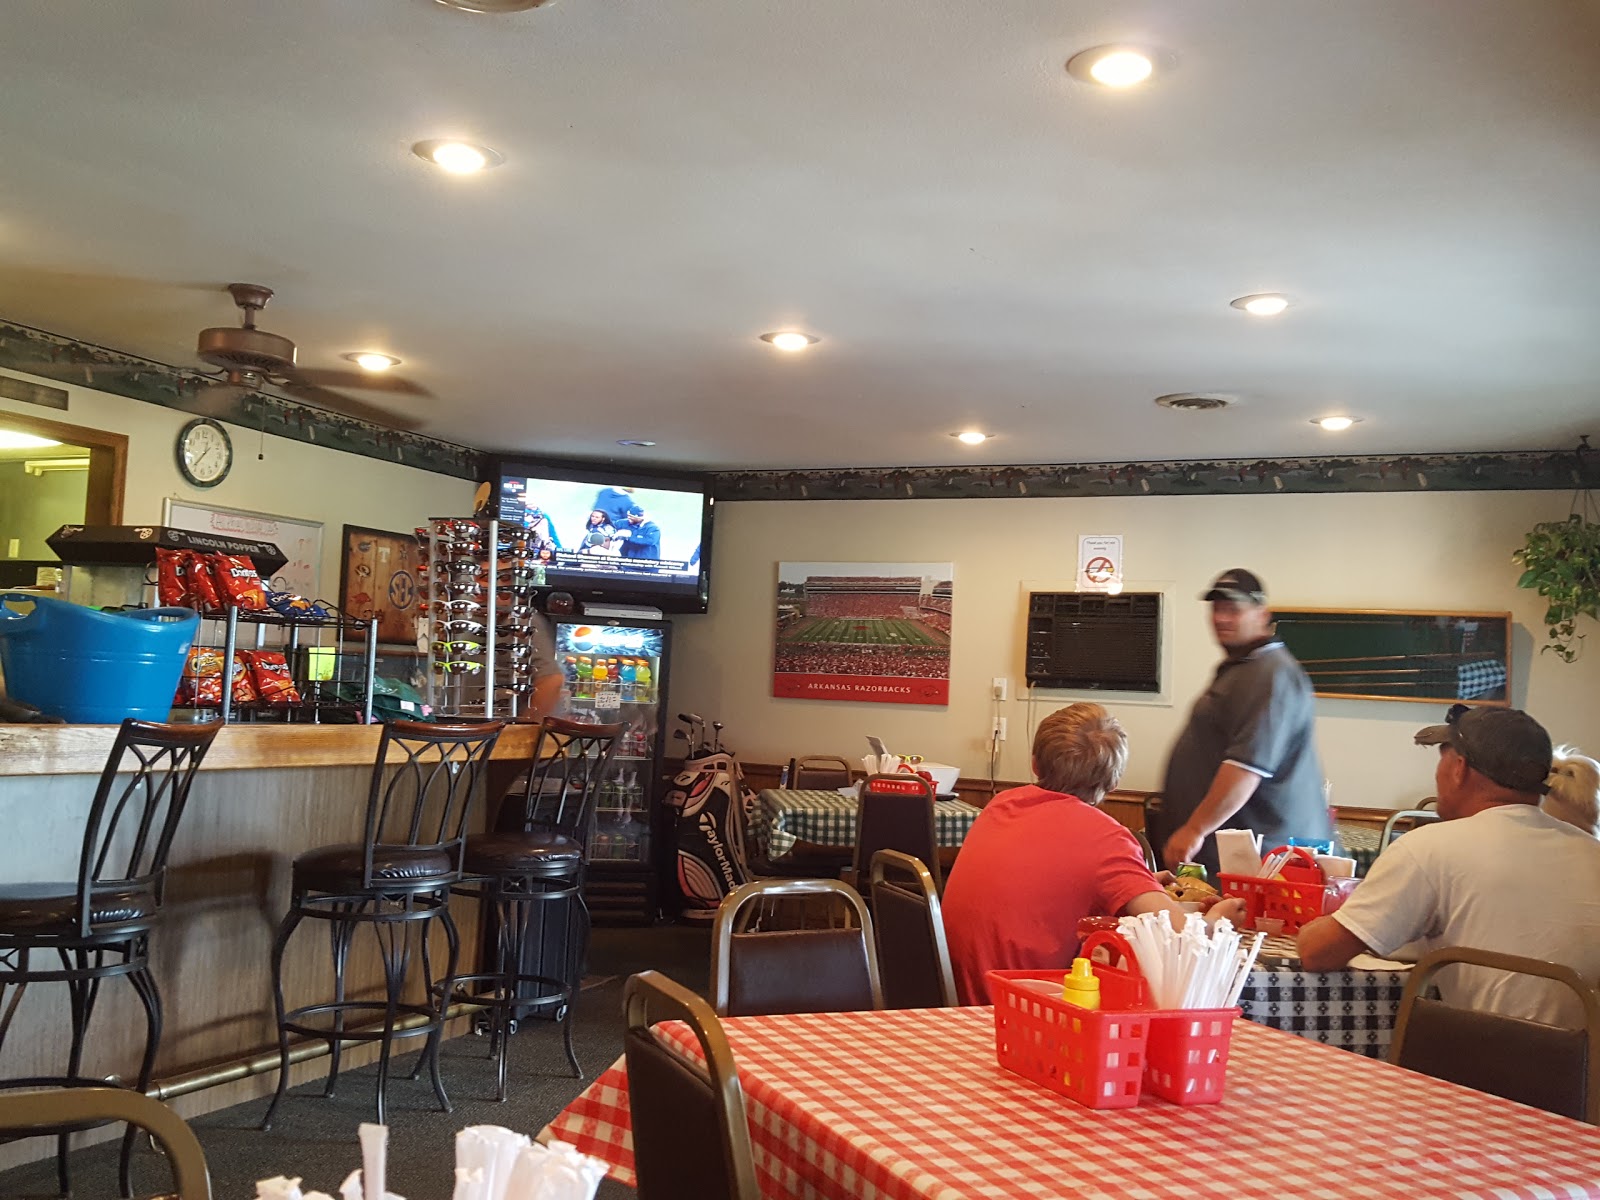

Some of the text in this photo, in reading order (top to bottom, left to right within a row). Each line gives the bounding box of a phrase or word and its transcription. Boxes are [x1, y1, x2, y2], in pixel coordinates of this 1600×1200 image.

[187, 535, 260, 553] LINCOLN POPPER
[231, 567, 258, 578] Doritos
[808, 682, 911, 694] ARKANSAS RAZORBACKS
[699, 811, 739, 891] TaylorMad
